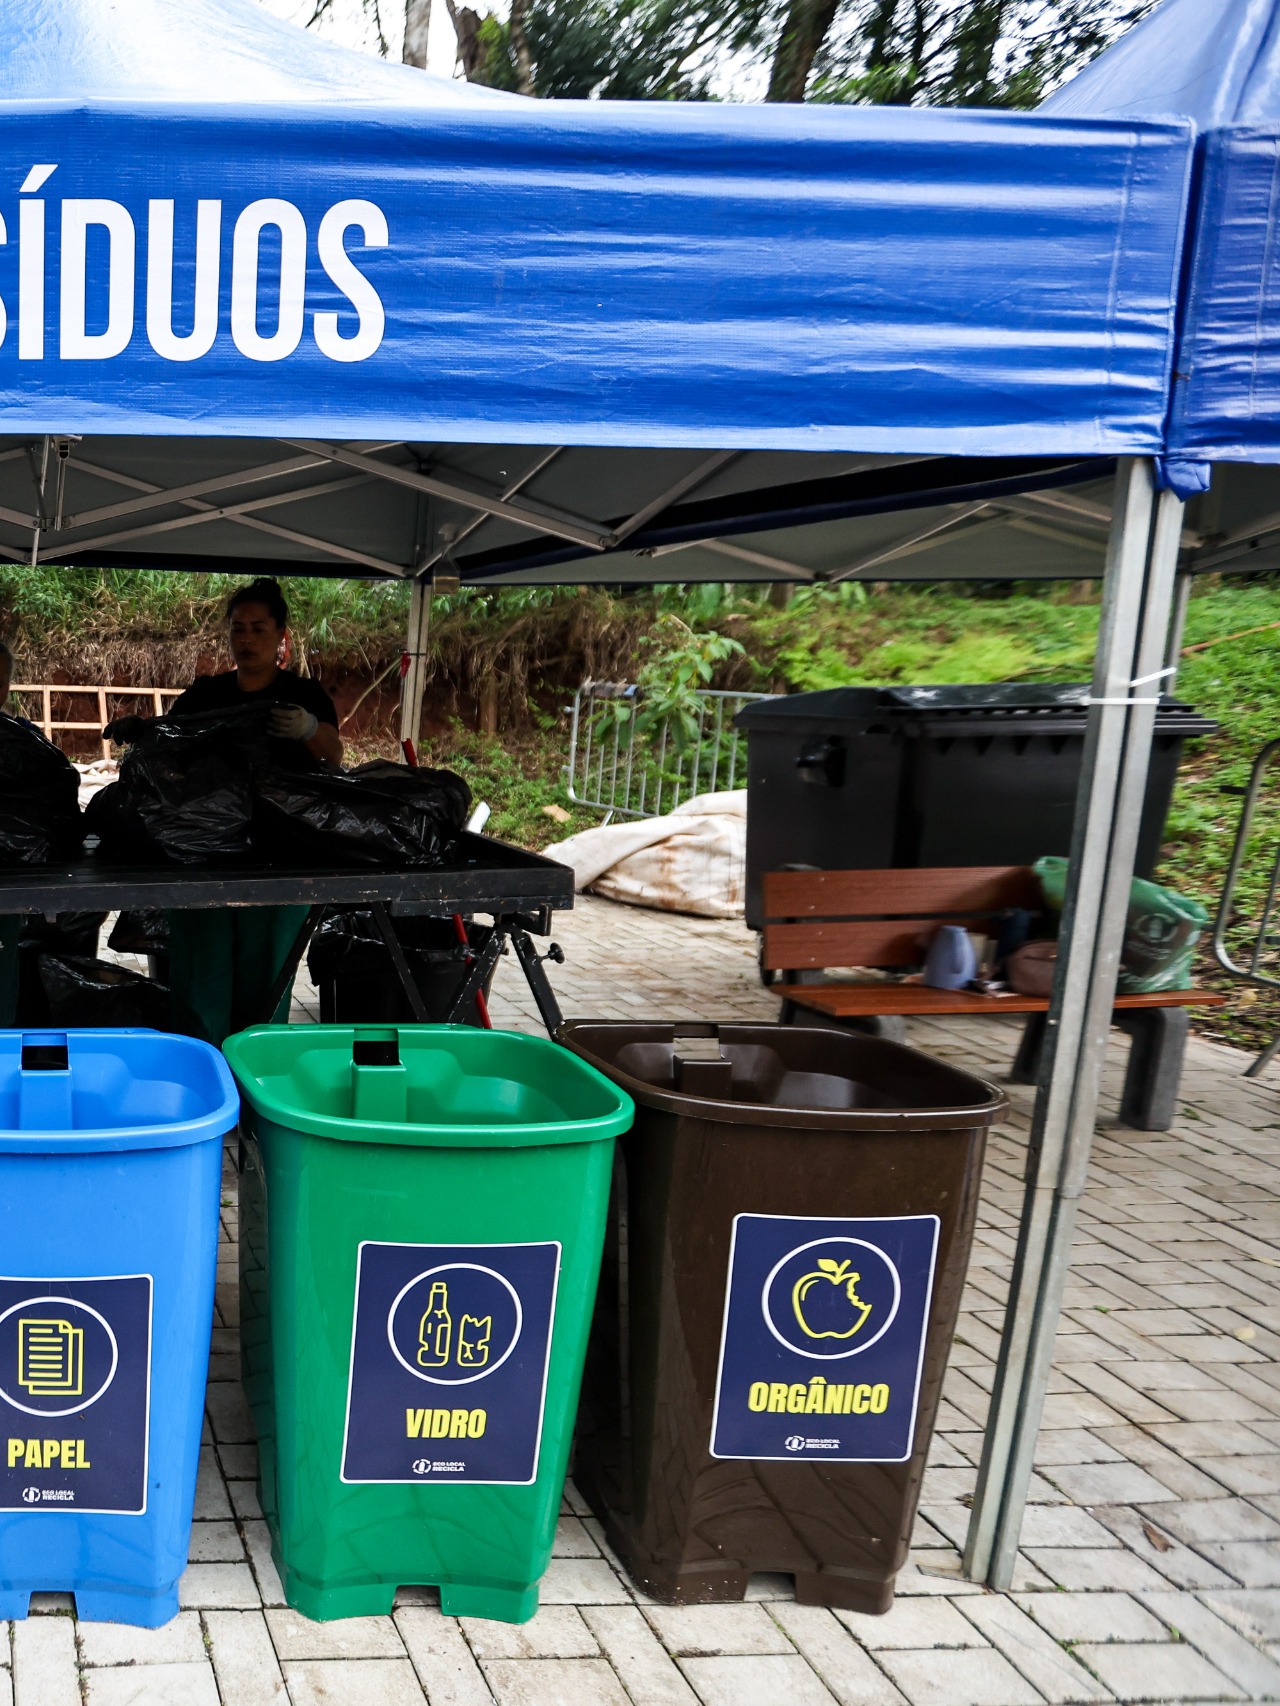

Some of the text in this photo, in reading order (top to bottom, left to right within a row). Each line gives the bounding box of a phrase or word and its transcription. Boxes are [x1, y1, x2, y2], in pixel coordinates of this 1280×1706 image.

[748, 1376, 890, 1414] ORGÂNICO
[406, 1408, 487, 1439] VIDRO
[7, 1438, 91, 1469] PAPEL
